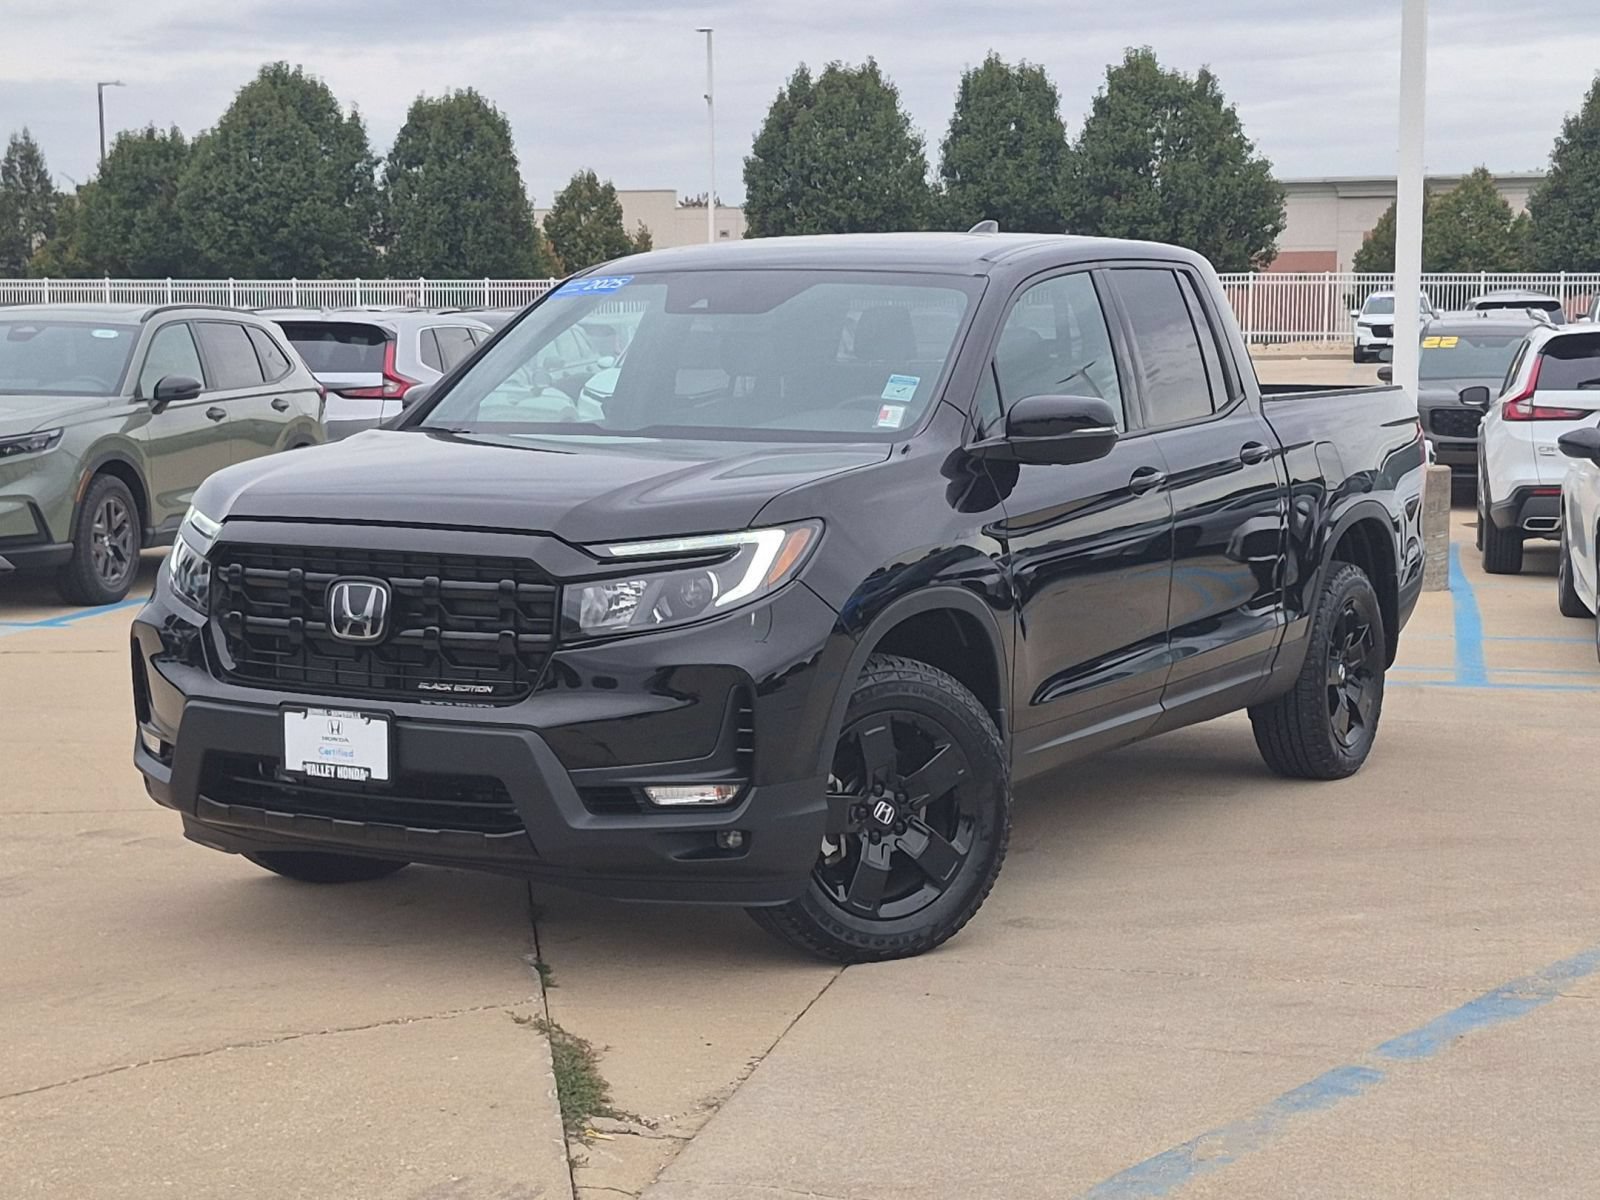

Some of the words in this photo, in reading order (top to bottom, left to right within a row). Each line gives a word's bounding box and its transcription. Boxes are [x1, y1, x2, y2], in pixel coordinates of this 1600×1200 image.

[1422, 336, 1459, 349] 22
[418, 682, 453, 691] BLACK
[454, 684, 494, 693] EDITION
[319, 746, 354, 758] Certified
[306, 763, 336, 778] VALLEY
[337, 766, 366, 781] HONDA
